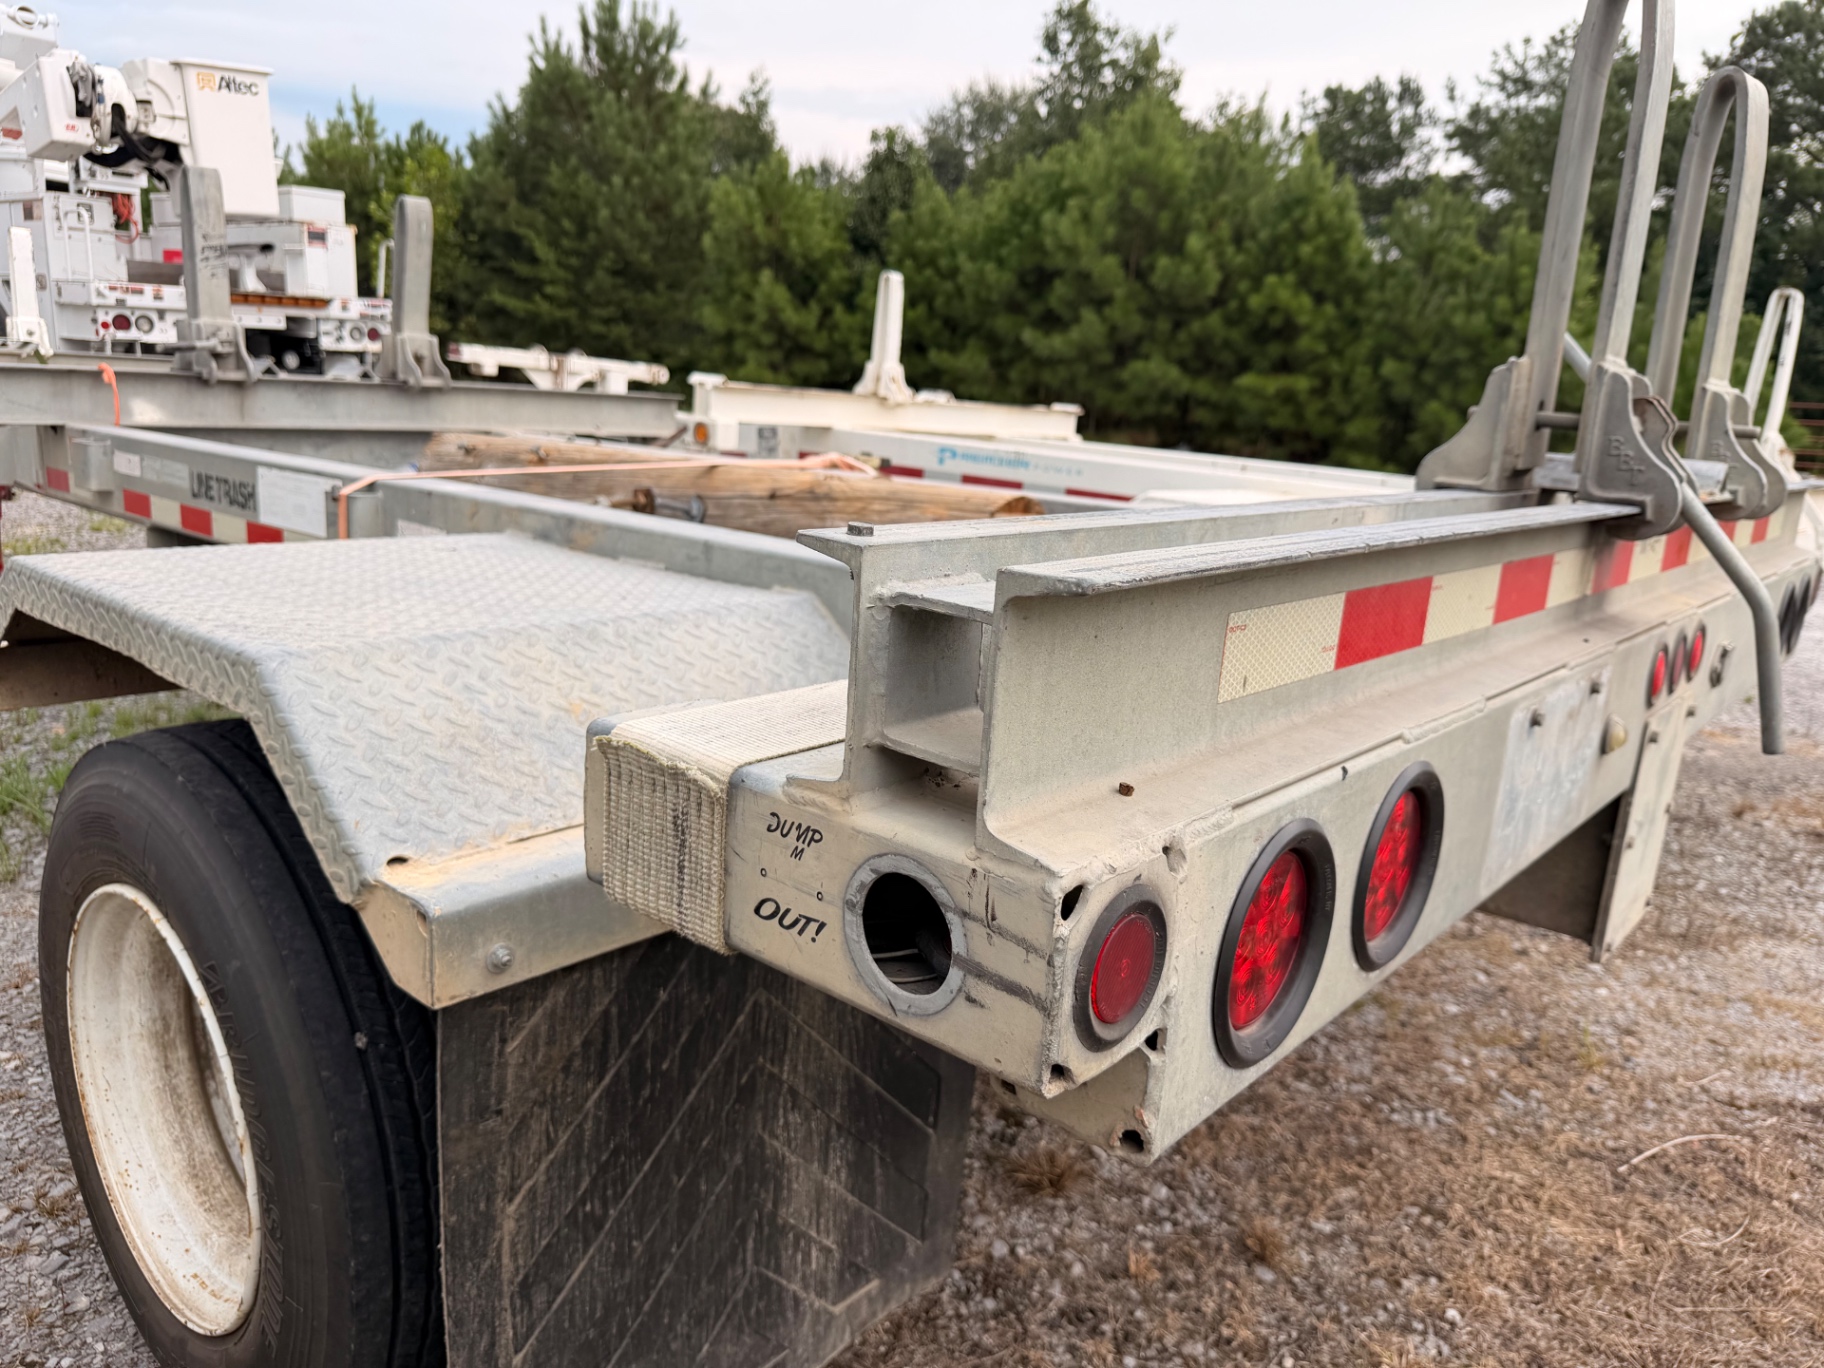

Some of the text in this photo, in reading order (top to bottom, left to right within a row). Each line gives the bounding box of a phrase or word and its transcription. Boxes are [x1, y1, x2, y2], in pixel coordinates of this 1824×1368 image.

[217, 74, 260, 97] Altec
[789, 845, 806, 861] M
[753, 897, 828, 944] OUT!
